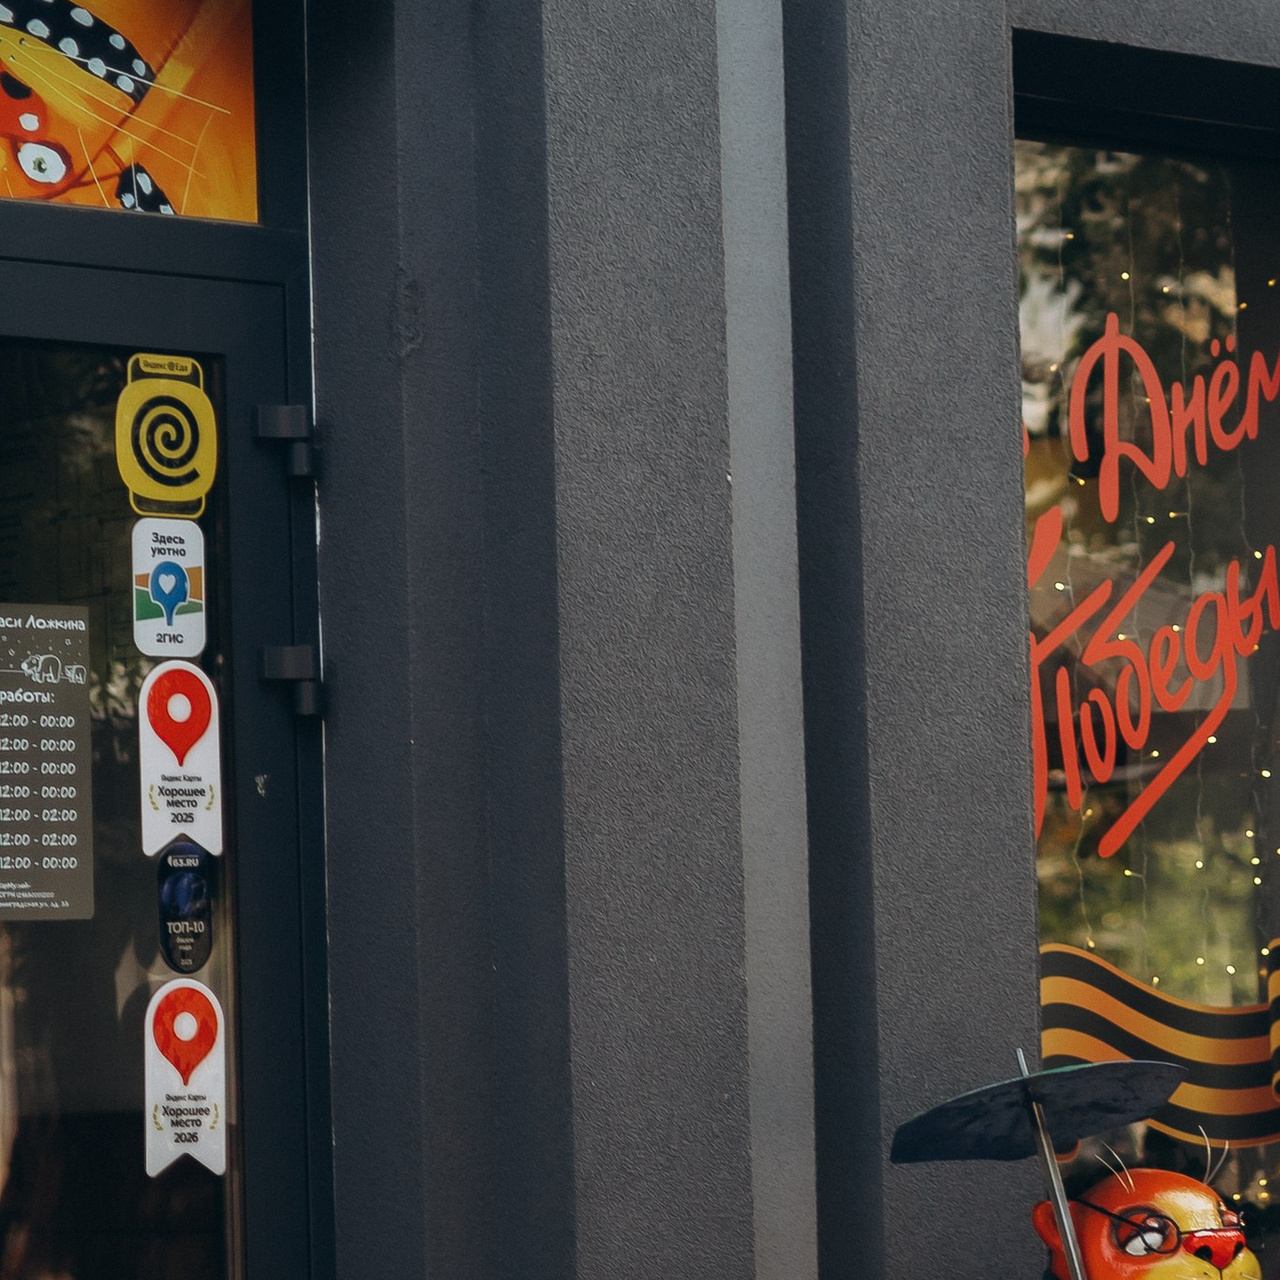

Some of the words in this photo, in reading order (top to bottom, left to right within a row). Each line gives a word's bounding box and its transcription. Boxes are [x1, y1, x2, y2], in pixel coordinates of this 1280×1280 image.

[152, 532, 185, 545] Здесь
[150, 546, 187, 558] уютно
[25, 614, 86, 631] Ложкина
[156, 633, 184, 644] 2ГИС
[0, 714, 29, 727] 2:00
[40, 715, 75, 728] 00:00
[40, 739, 76, 752] 00:00
[41, 762, 76, 775] 00:00
[41, 786, 77, 799] 00:00
[157, 785, 206, 799] Хорошее
[166, 798, 198, 808] место
[42, 809, 78, 822] 02:00
[170, 812, 195, 823] 2025
[41, 833, 78, 846] 02:00
[42, 857, 78, 869] 00:00
[166, 920, 205, 934] ТОП-10
[161, 1105, 210, 1118] Хорошее
[171, 1118, 202, 1128] место
[174, 1131, 199, 1143] 2026
